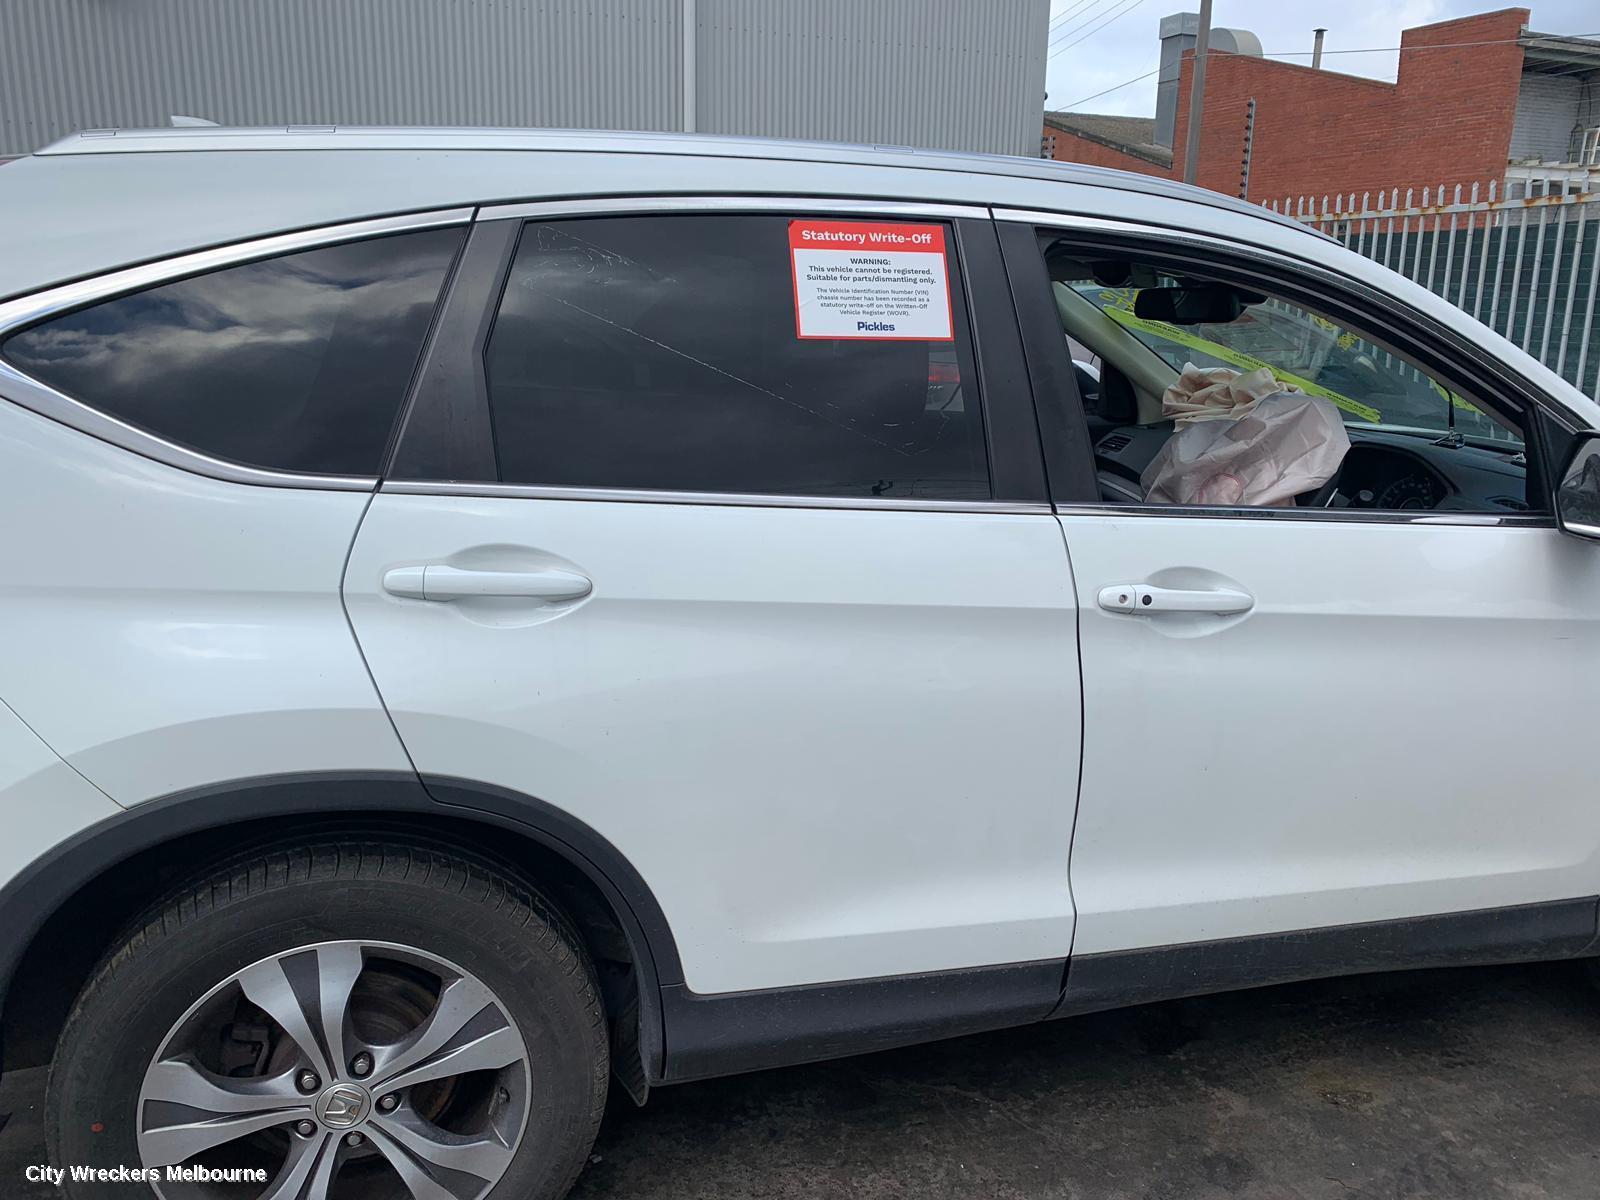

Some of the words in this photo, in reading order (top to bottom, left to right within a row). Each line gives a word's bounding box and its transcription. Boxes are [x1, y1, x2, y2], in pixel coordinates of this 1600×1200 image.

[801, 229, 866, 244] Statutory
[869, 231, 932, 244] Write-Off
[850, 257, 891, 265] WARNING:
[826, 265, 853, 273] vehicle
[893, 268, 933, 276] registered.
[806, 273, 838, 281] Suitable
[852, 275, 918, 284] parts/dismantling
[919, 277, 936, 285] only.
[851, 287, 890, 295] Identification
[862, 309, 886, 317] Register
[857, 321, 896, 332] Pickles
